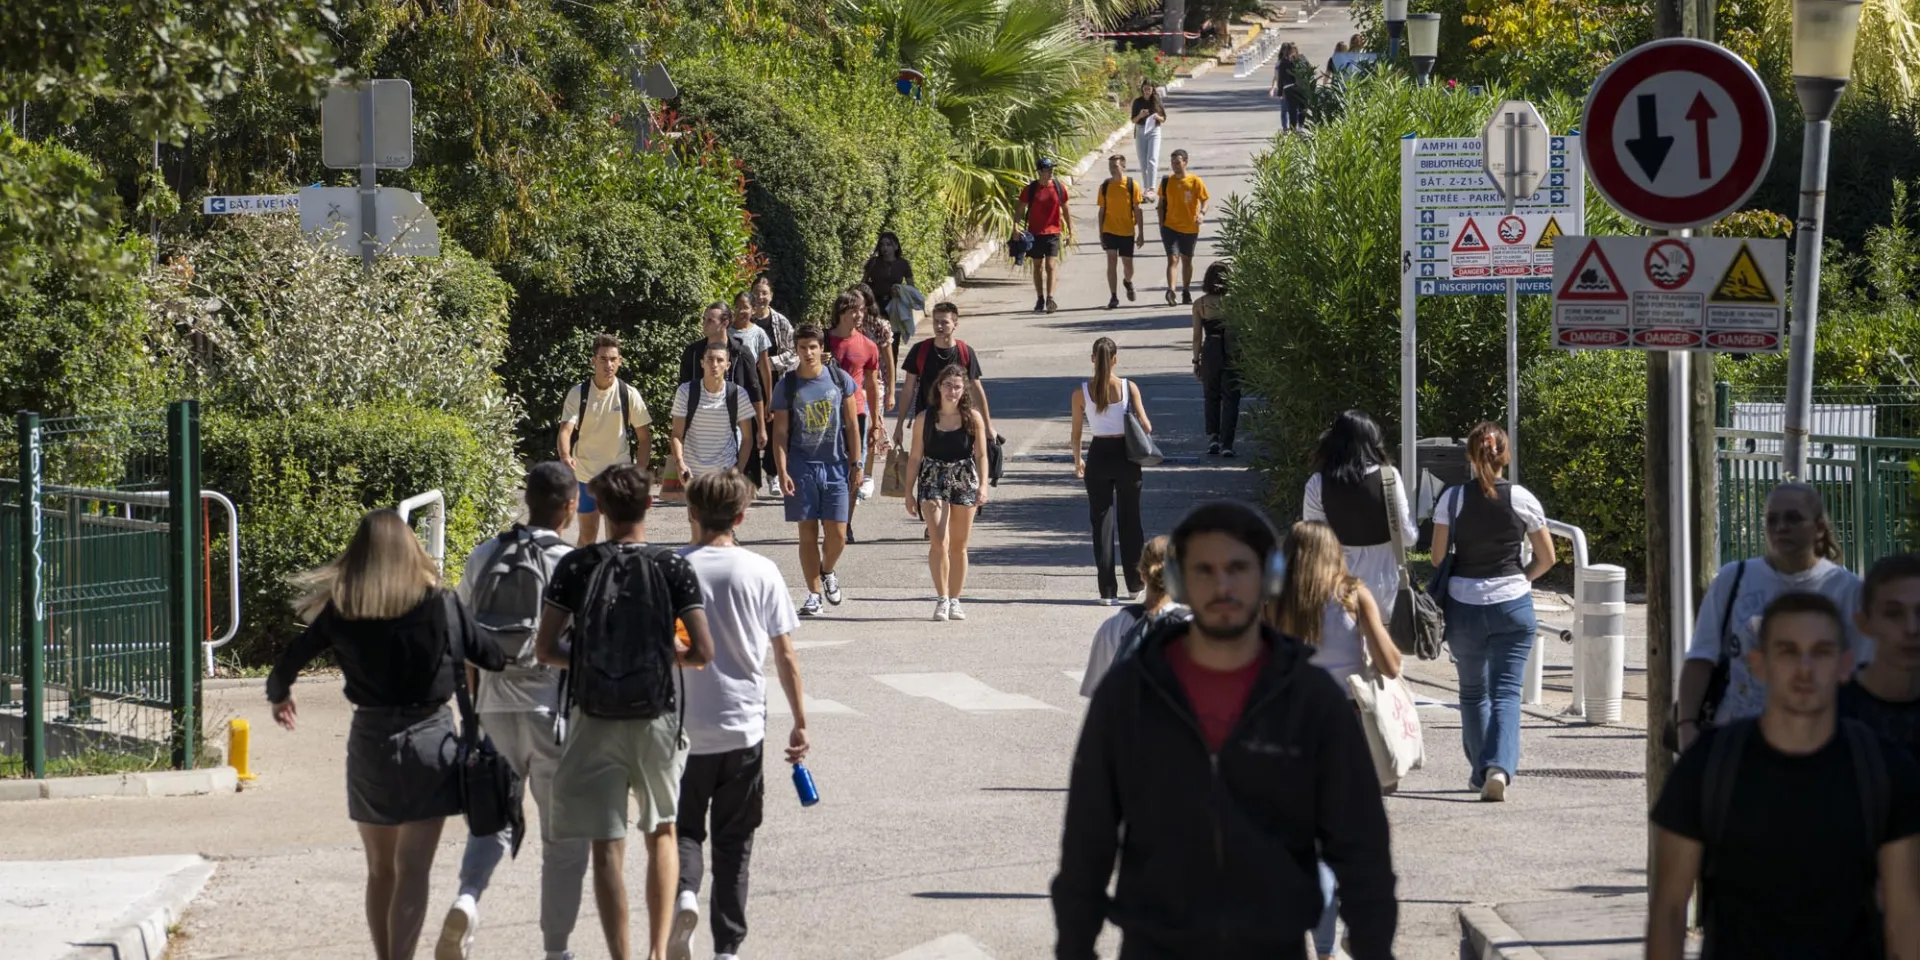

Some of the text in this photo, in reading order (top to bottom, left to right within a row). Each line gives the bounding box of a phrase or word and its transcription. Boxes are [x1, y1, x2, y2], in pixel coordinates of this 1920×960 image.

[1421, 141, 1481, 150] AMPHI 400
[1420, 158, 1483, 168] BIBLIOTHÈQUE
[1420, 176, 1484, 187] BÂT. Z-Z1-S
[1420, 192, 1458, 203] ENTRÉE
[1469, 193, 1503, 202] PARKI
[1439, 282, 1506, 291] INSCRIPTIONS
[1569, 331, 1617, 343] DANGER
[1645, 331, 1690, 345] DANGER
[1717, 334, 1766, 346] DANGER
